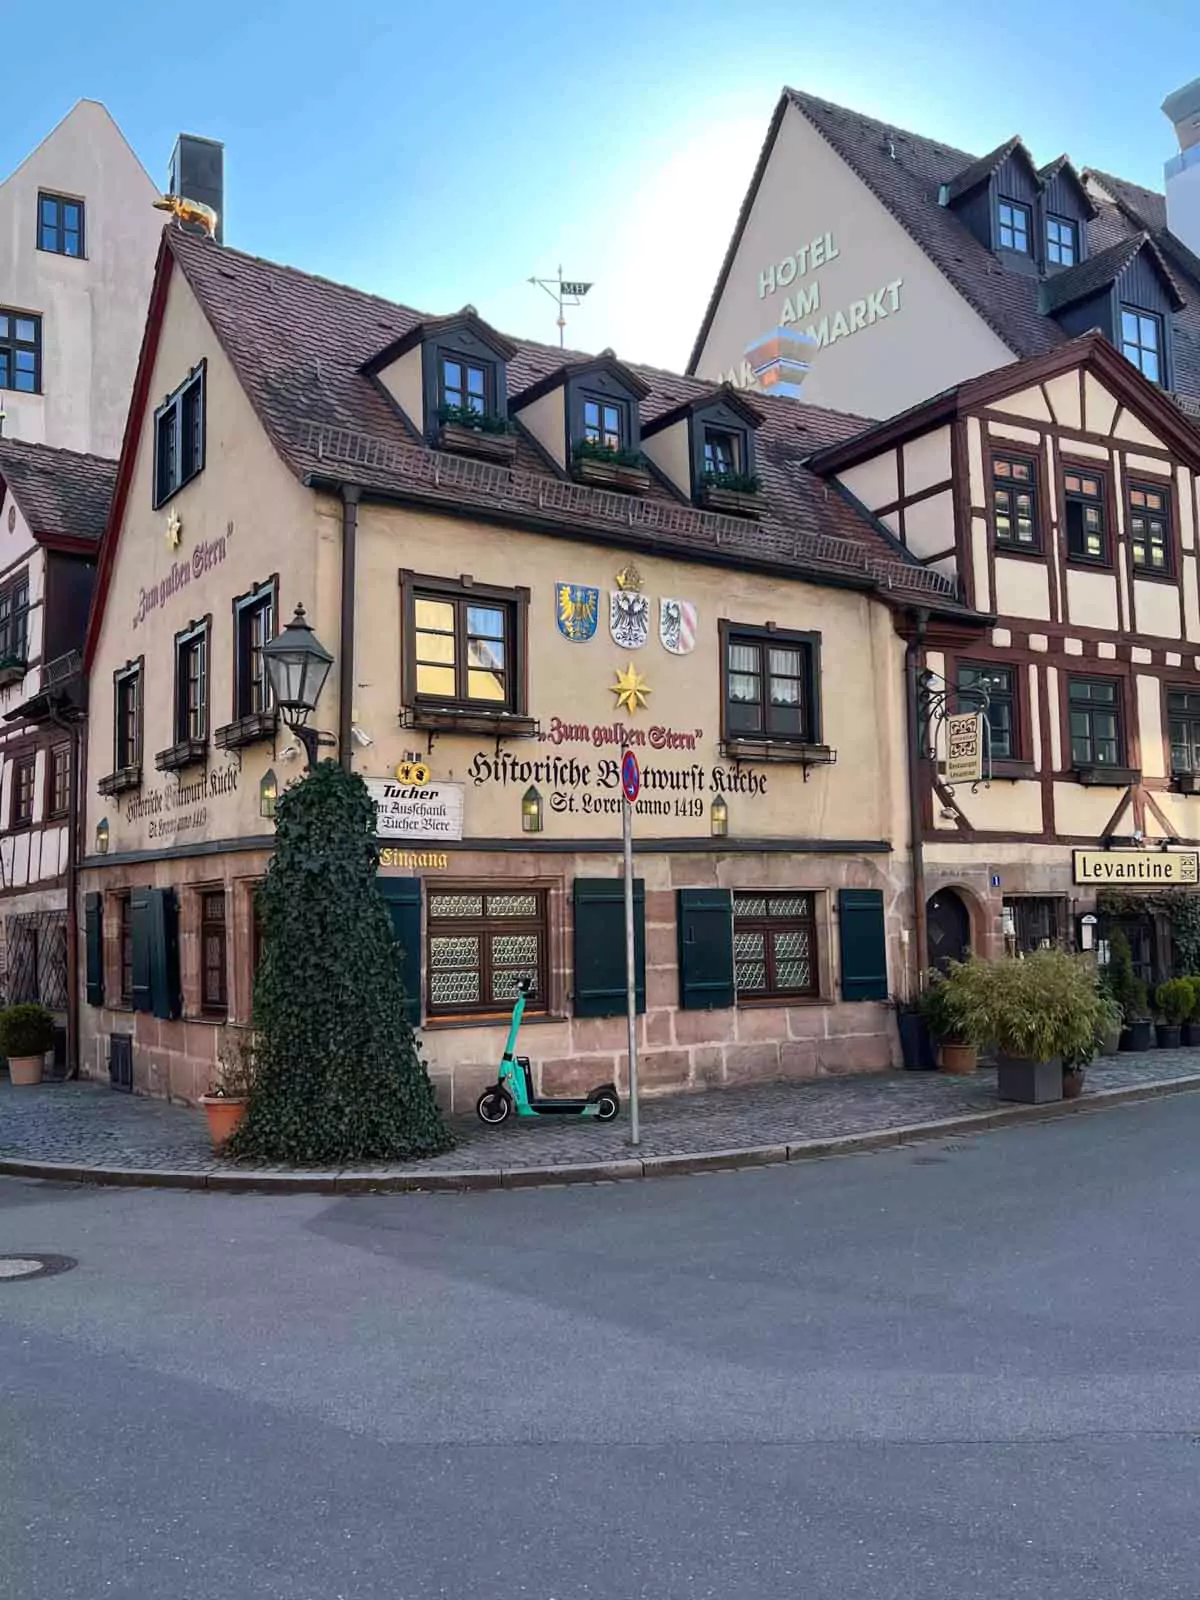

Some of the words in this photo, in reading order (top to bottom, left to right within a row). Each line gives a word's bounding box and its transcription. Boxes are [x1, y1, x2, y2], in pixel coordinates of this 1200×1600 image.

[758, 231, 840, 299] HOTEL
[782, 281, 820, 326] AM
[596, 759, 705, 794] Btwurst
[709, 766, 768, 799] Küche
[384, 785, 439, 800] Tucher
[550, 792, 579, 813] St.
[582, 793, 624, 814] Loren
[635, 799, 671, 815] anno
[674, 797, 704, 817] 1419
[382, 816, 419, 830] Tucher
[421, 818, 451, 831] Biere
[379, 847, 448, 869] Eingang
[1082, 856, 1173, 878] Levantine
